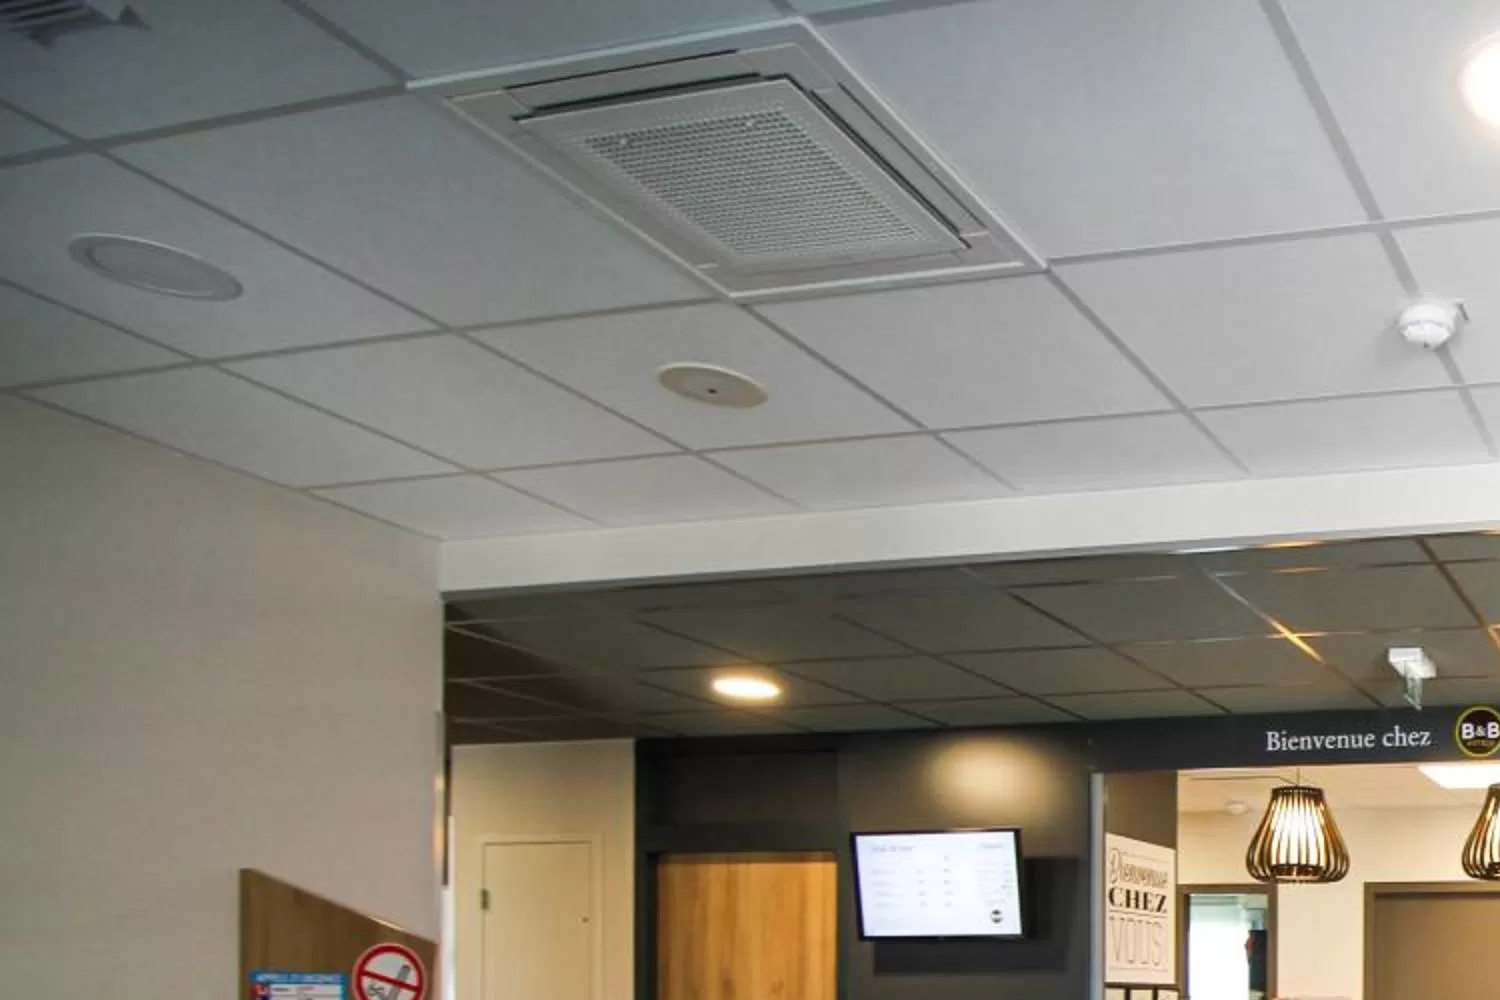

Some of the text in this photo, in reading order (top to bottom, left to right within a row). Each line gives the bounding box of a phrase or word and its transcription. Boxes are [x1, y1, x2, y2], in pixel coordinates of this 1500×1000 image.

[1266, 725, 1432, 751] Bienvenue chez
[1461, 722, 1500, 739] B&B
[1108, 887, 1167, 913] CHEZ
